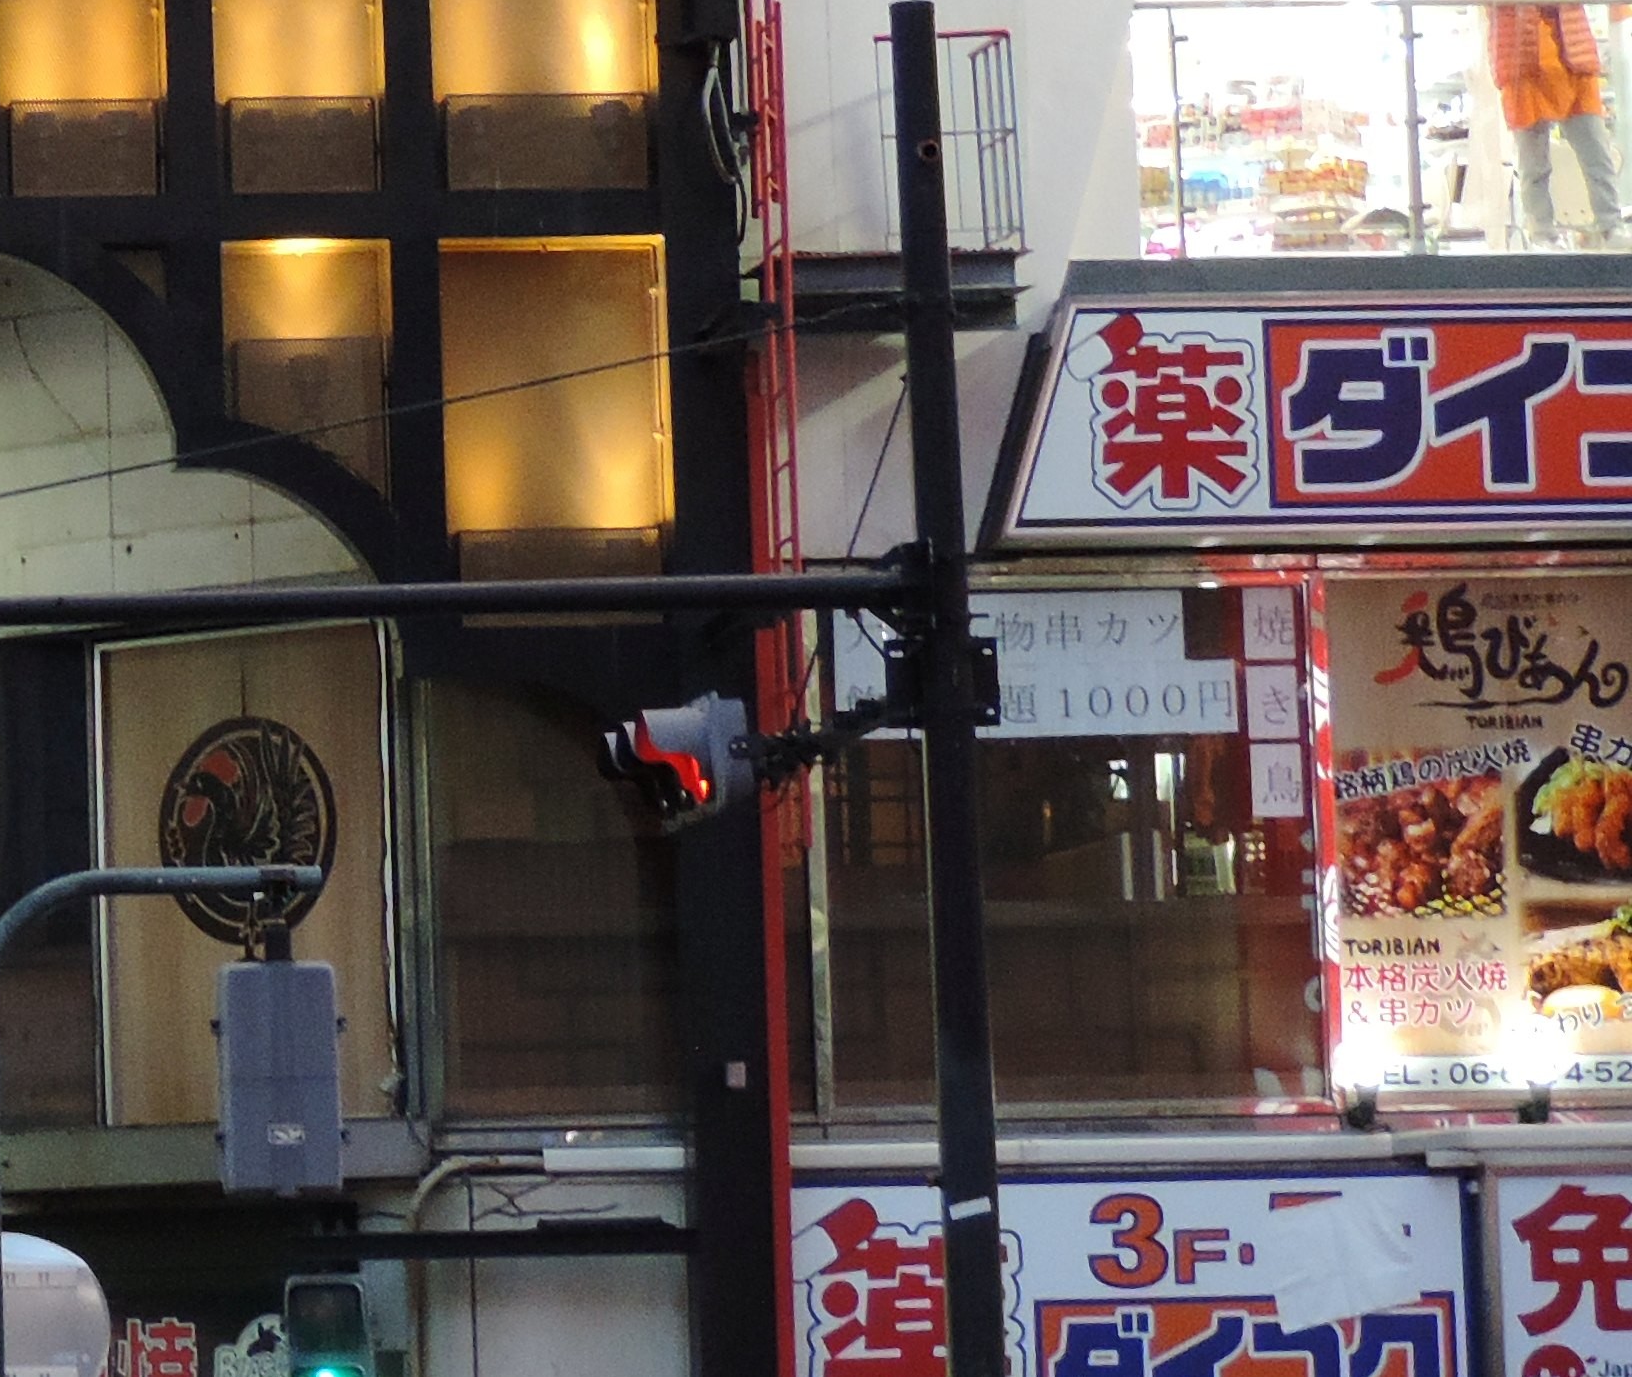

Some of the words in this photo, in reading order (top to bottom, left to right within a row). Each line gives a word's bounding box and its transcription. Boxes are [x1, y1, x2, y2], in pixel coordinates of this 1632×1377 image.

[1099, 313, 1249, 499] 薬
[1342, 936, 1441, 957] TORIBIAN
[1344, 960, 1509, 993] 本格炭火焼
[1378, 997, 1475, 1026] 串カツ
